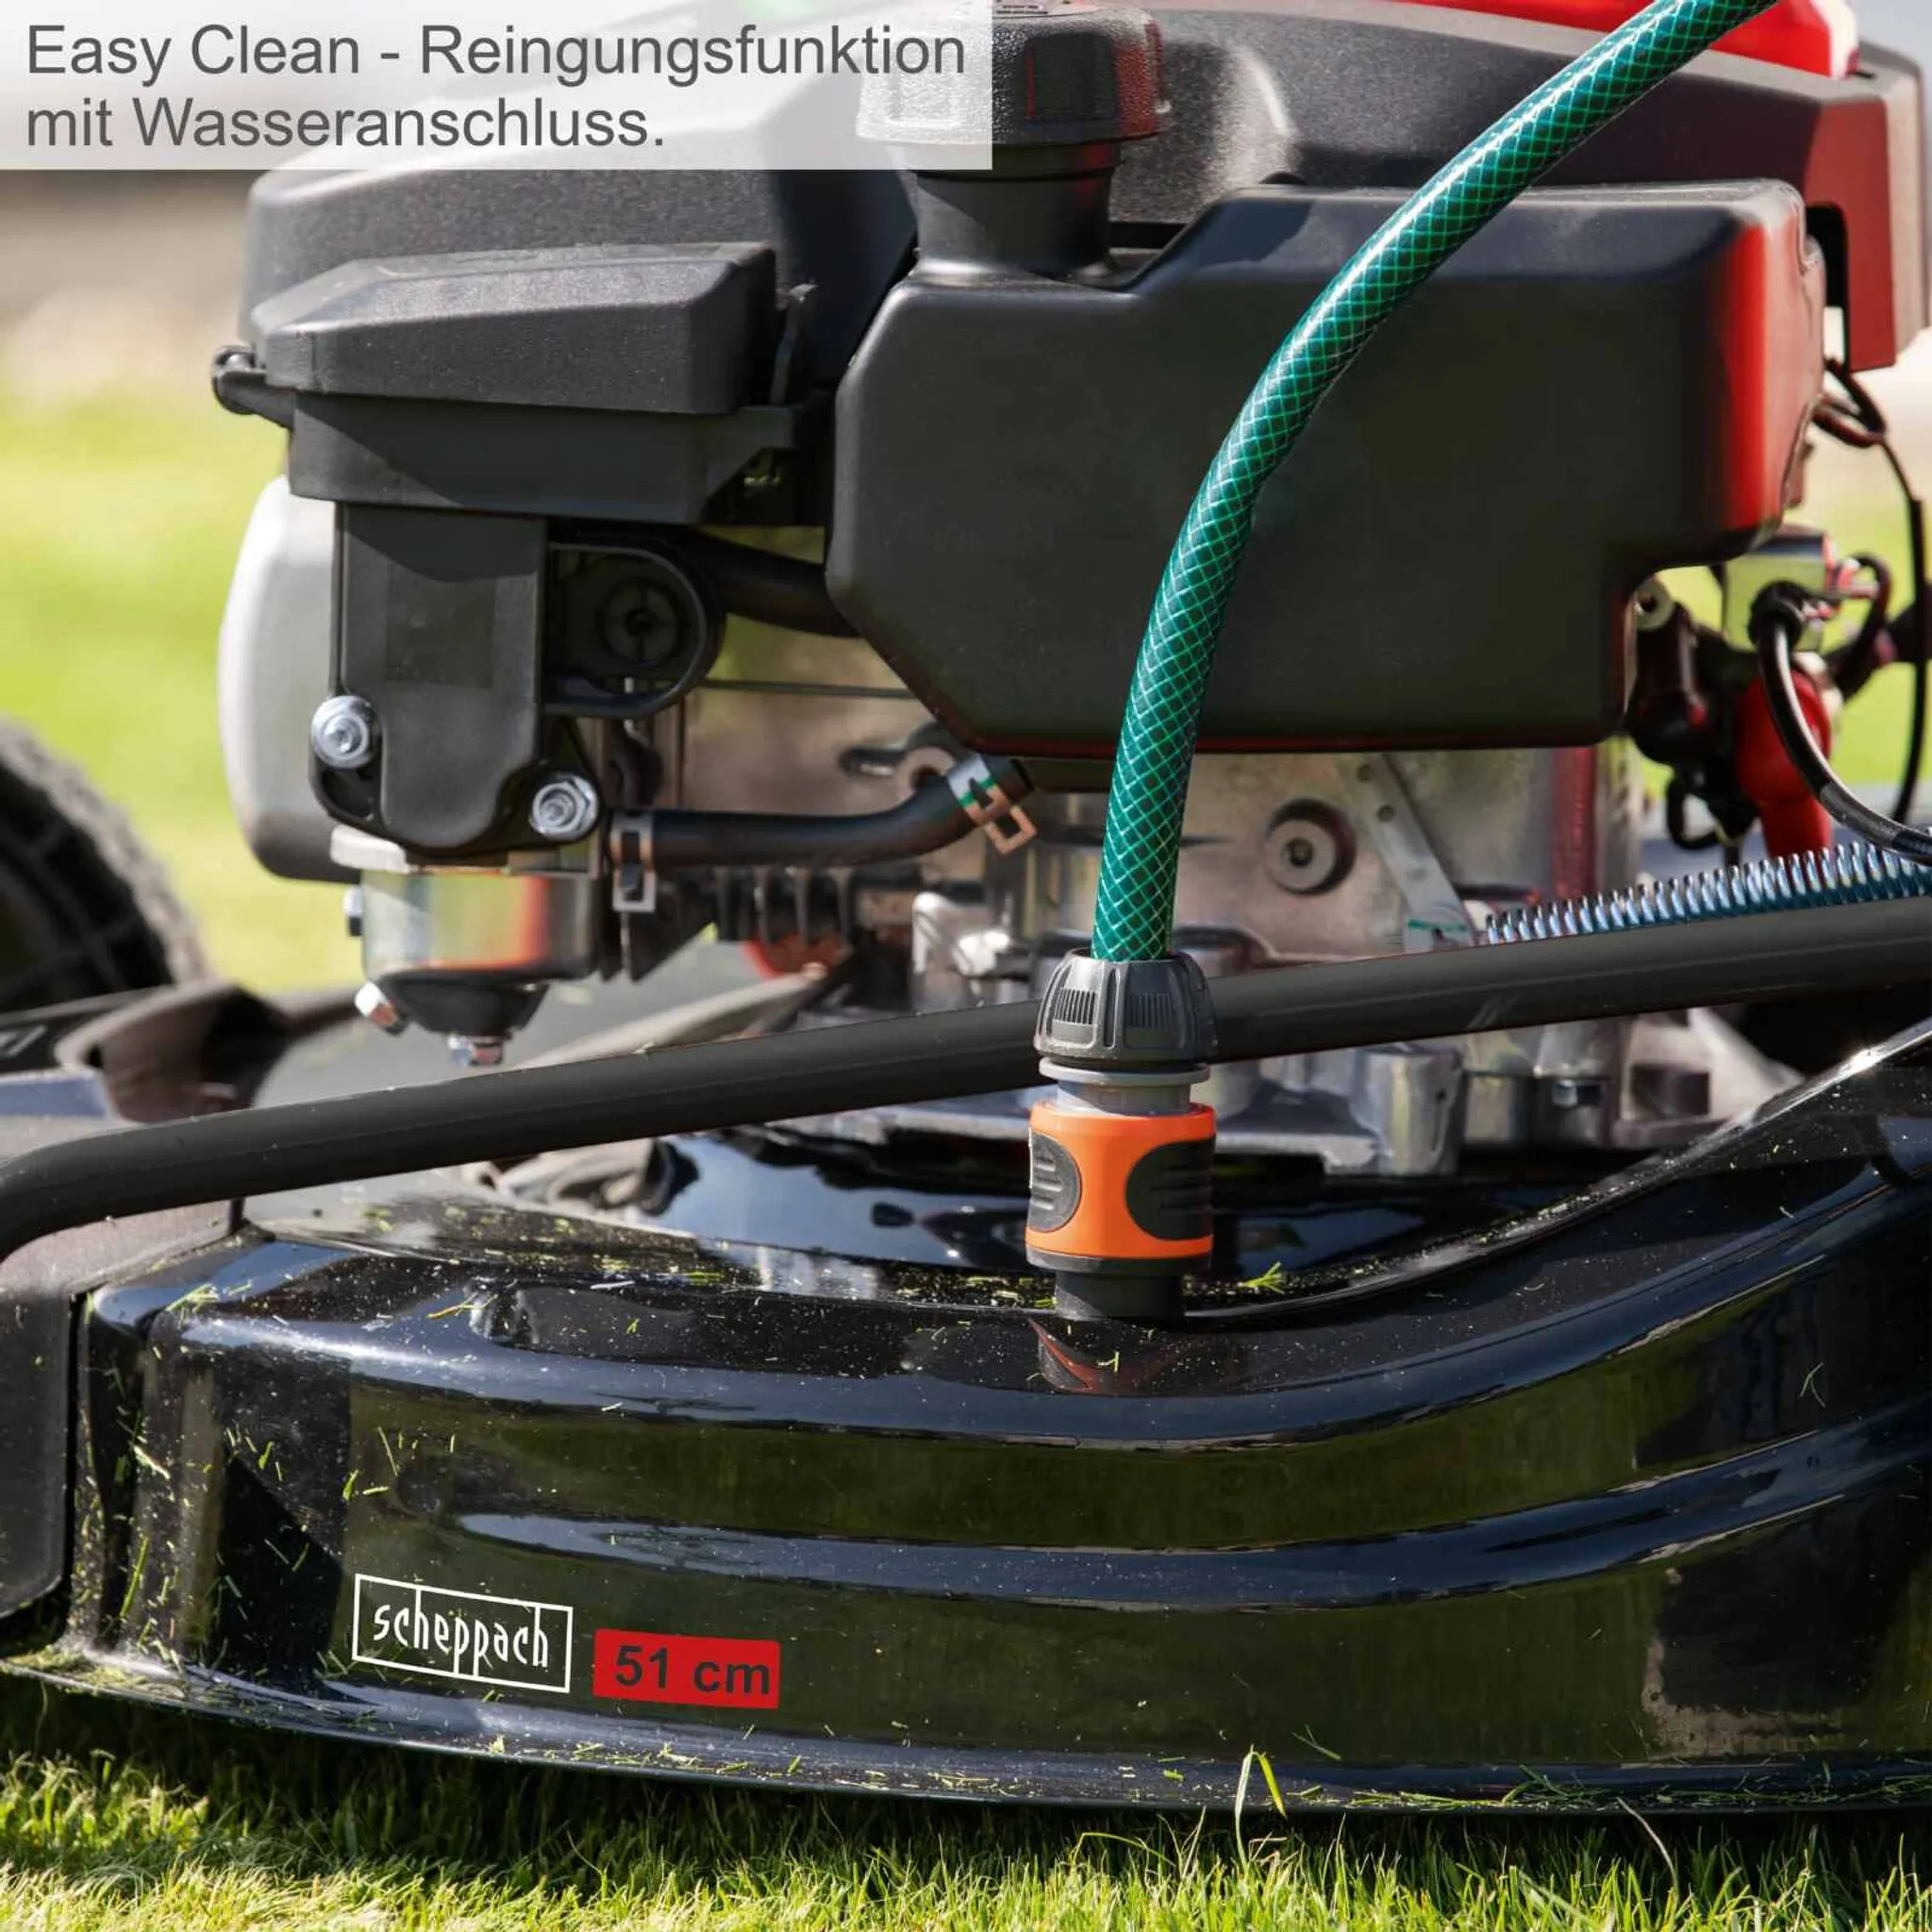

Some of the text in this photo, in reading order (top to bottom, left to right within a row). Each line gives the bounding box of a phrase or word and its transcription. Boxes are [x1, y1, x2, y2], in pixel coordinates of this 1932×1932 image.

[373, 1588, 550, 1677] scheppach
[615, 1645, 770, 1695] 51 cm
